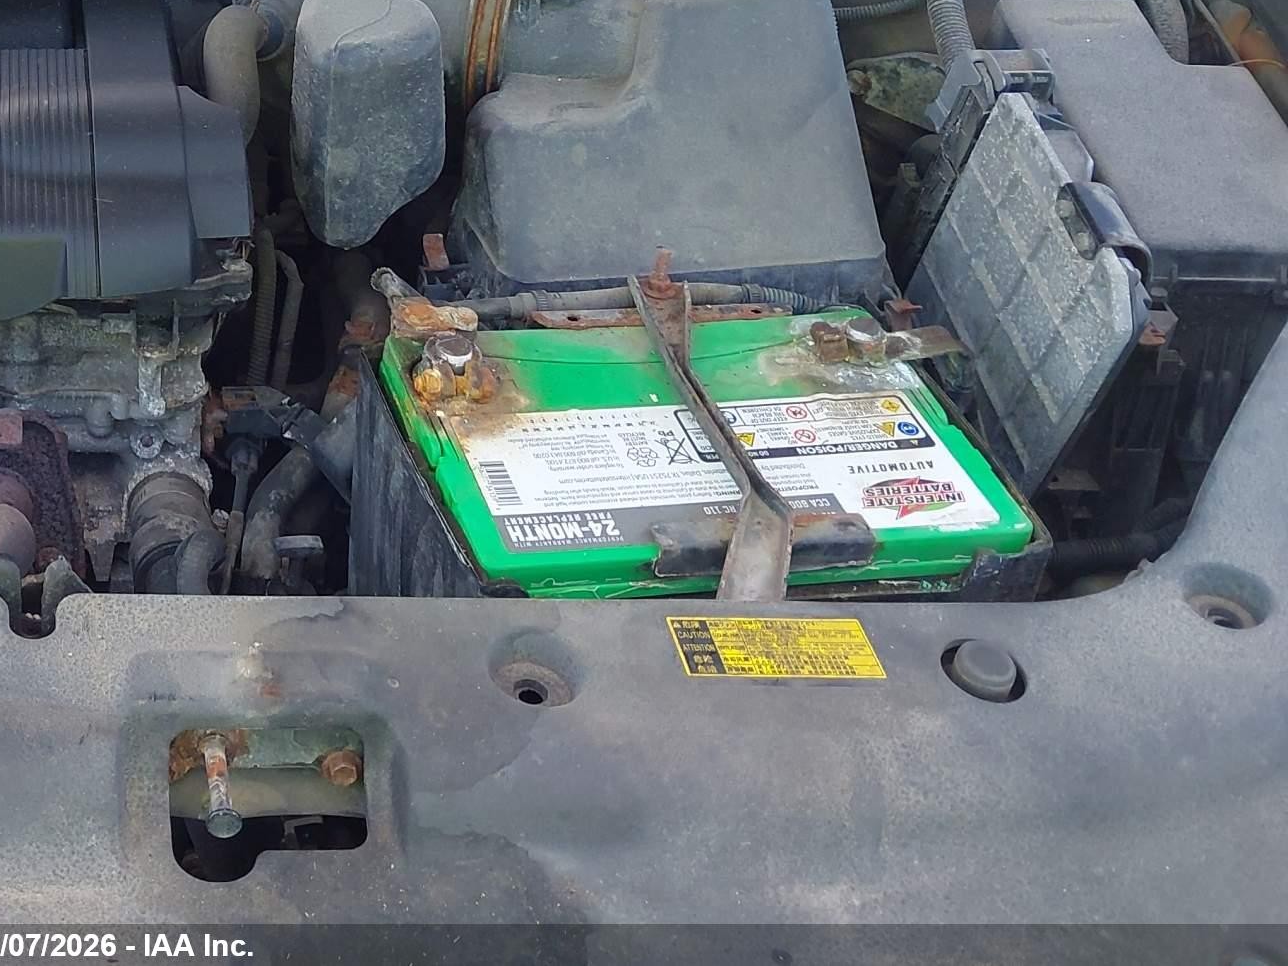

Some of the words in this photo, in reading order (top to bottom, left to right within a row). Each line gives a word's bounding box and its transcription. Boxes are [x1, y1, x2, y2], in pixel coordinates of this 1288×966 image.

[796, 440, 898, 454] DANGER/POISON
[847, 460, 934, 474] AUTOMOTIVE
[865, 483, 954, 496] BATTERIES
[808, 497, 831, 508] CCA
[864, 492, 964, 508] INTERSTATE
[584, 512, 613, 521] FREE
[703, 506, 722, 515] 110
[503, 513, 582, 526] REPLACEMENT
[506, 519, 621, 543] 24-MONTH
[677, 631, 711, 639] CAUTION
[682, 643, 716, 652] ATTENTION
